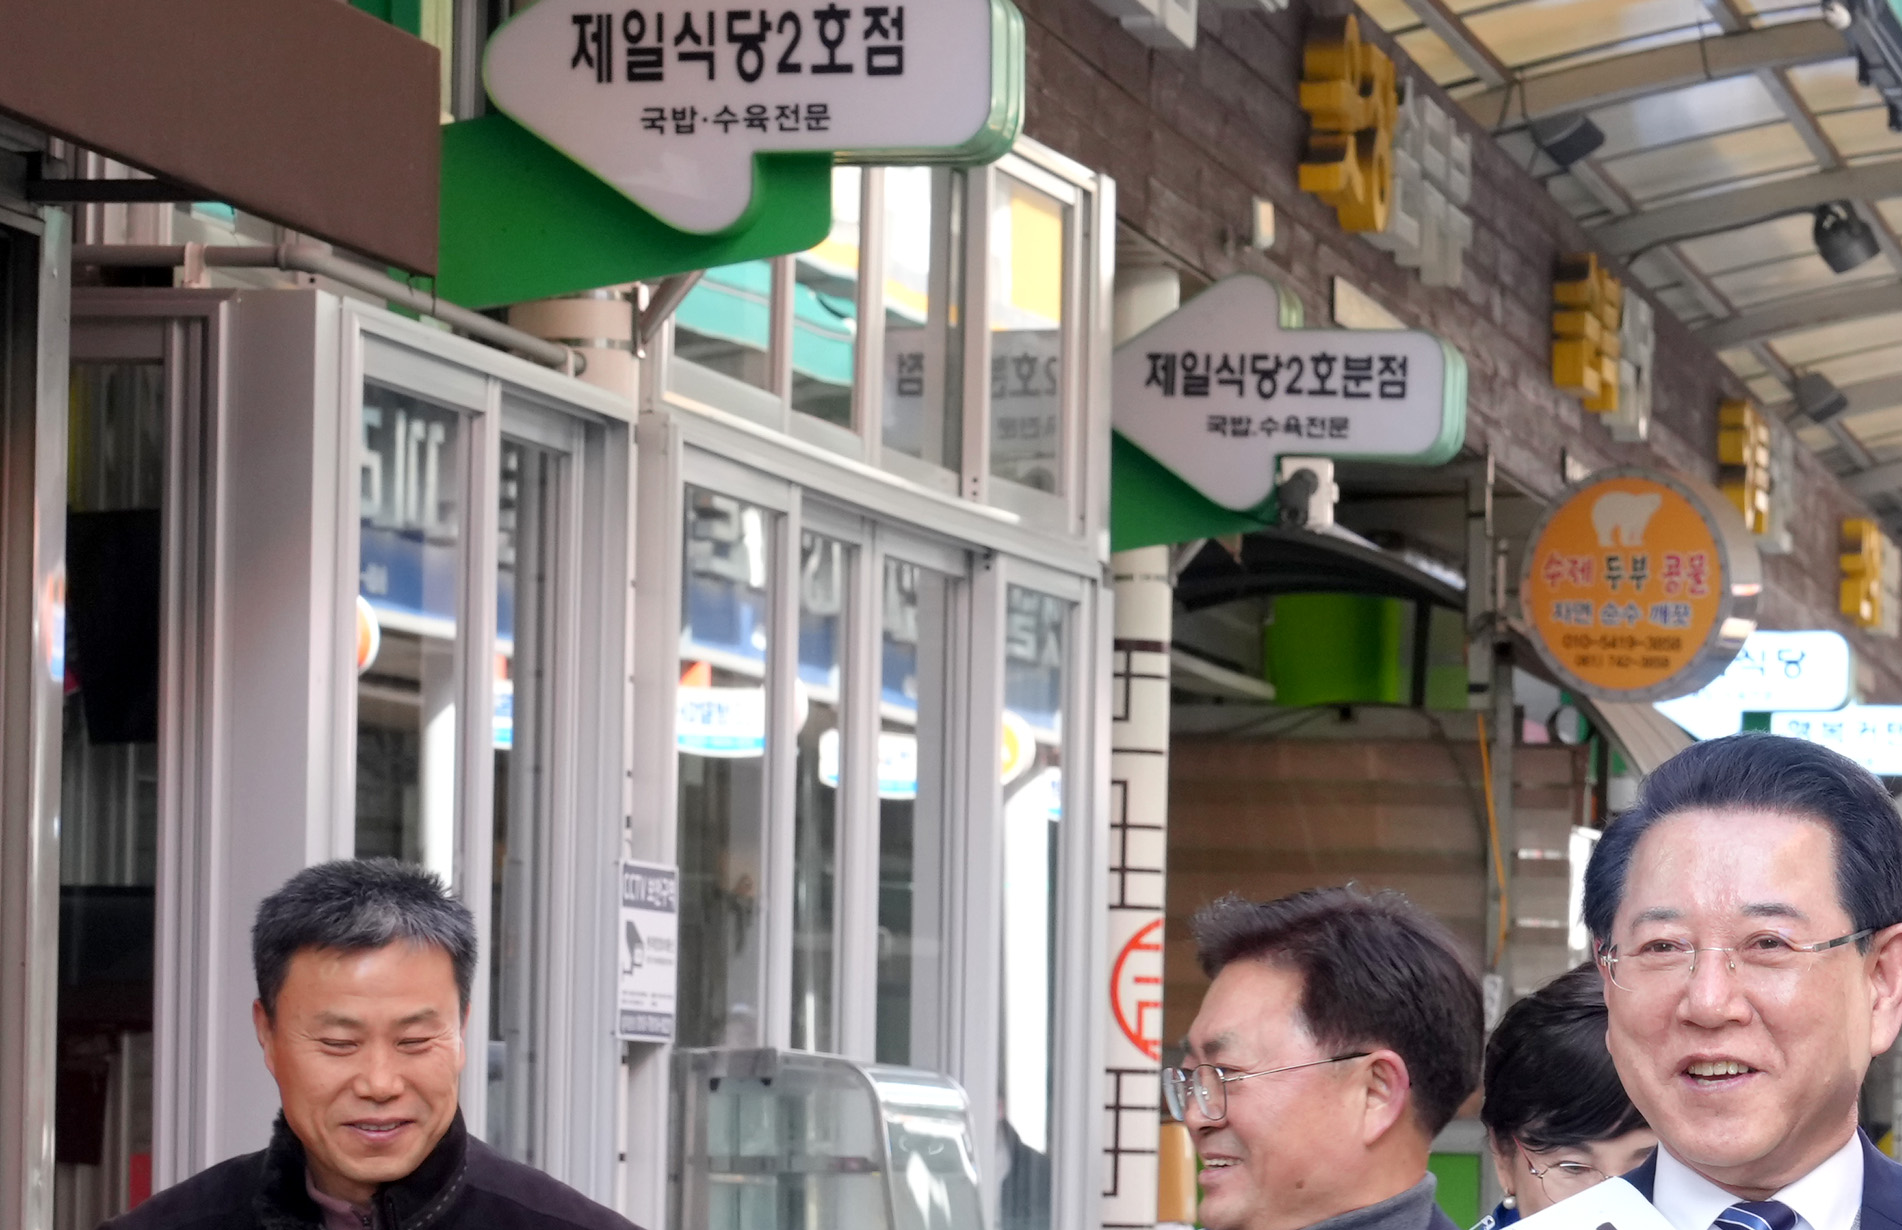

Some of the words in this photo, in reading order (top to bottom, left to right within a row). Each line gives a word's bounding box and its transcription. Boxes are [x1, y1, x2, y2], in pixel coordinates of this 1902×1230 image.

[569, 2, 907, 83] 제일식당2호점
[639, 102, 833, 134] 국밥·수육전문
[1143, 350, 1409, 401] 제일식당2호분점
[1544, 552, 1595, 588] 수제
[1605, 555, 1649, 591] 두부
